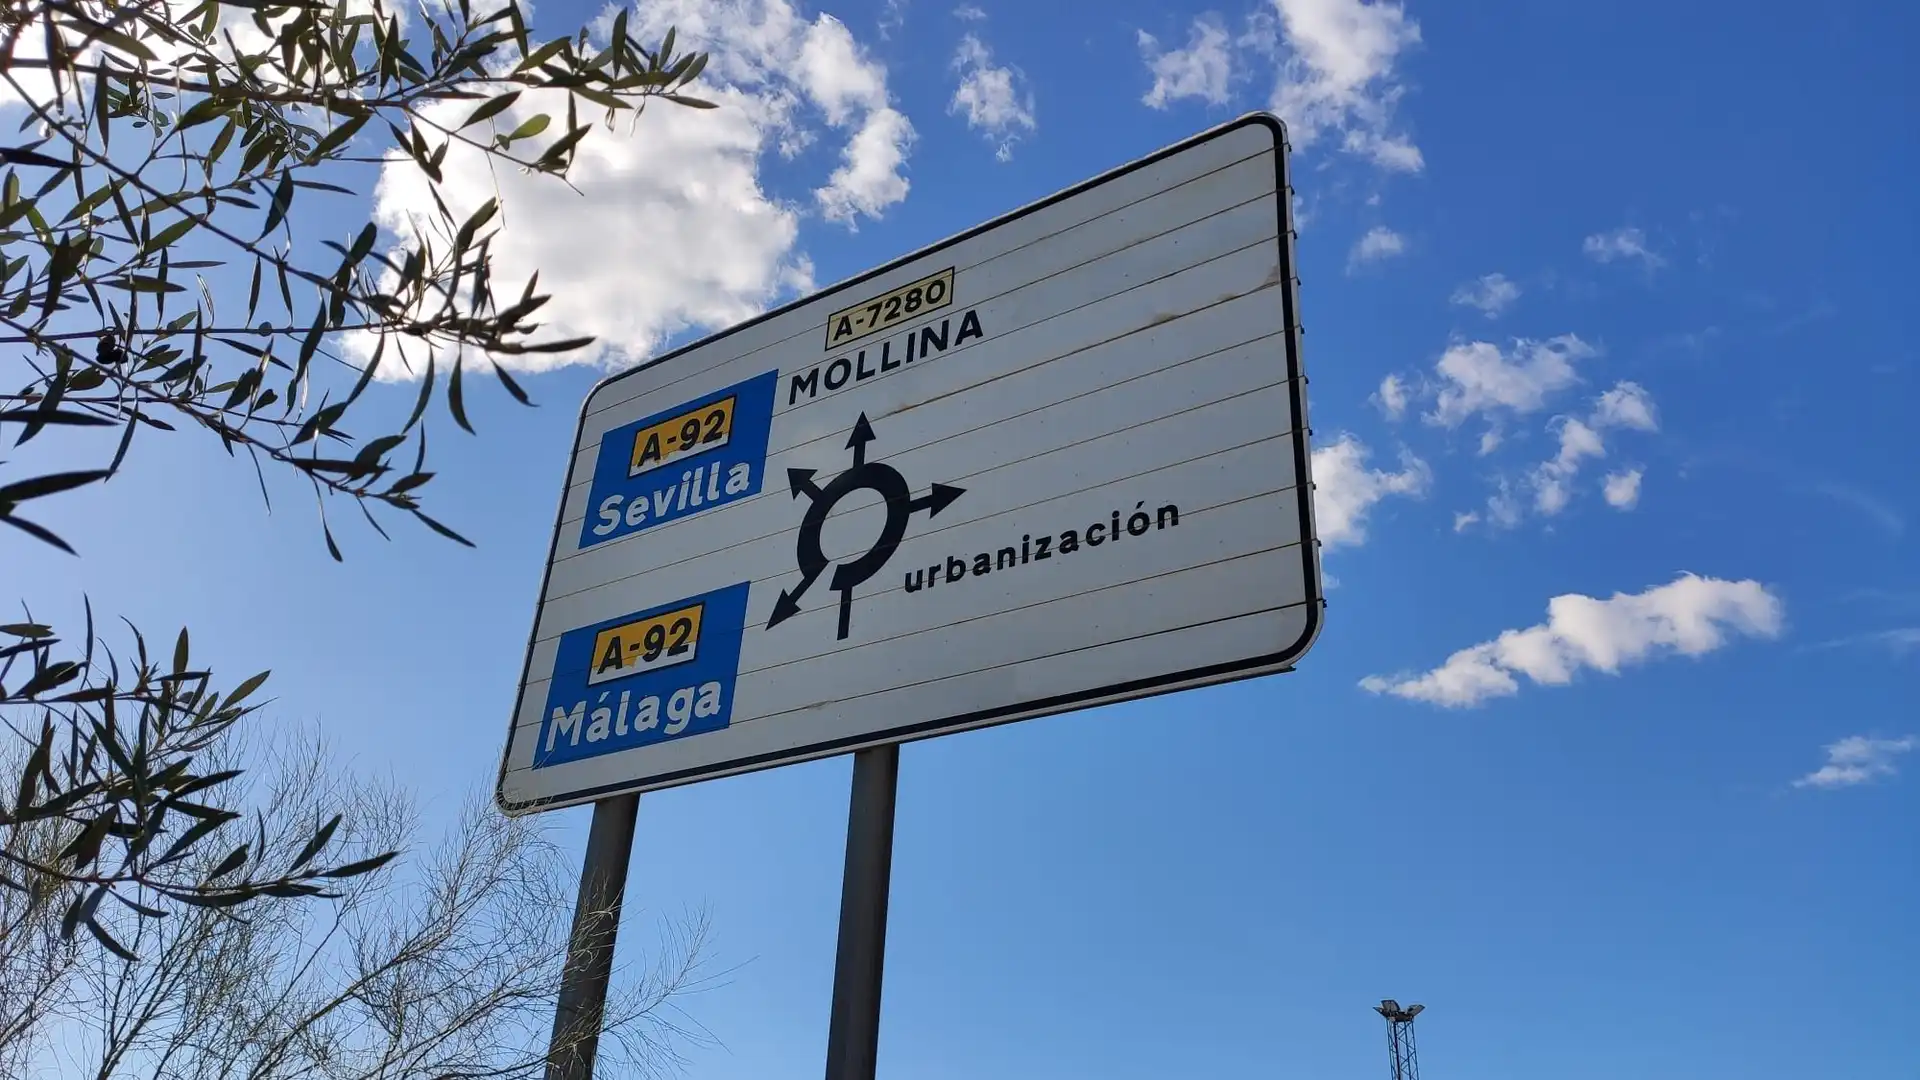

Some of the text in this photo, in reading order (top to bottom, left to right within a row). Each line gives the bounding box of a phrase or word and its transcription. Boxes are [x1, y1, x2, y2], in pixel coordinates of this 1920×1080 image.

[833, 279, 946, 341] A-7280
[789, 310, 984, 405] MOLLINA
[637, 409, 726, 467] A-92
[592, 461, 751, 535] Sevilla
[904, 501, 1179, 593] urbanización
[597, 617, 692, 675] A-92
[545, 681, 722, 753] Málaga
